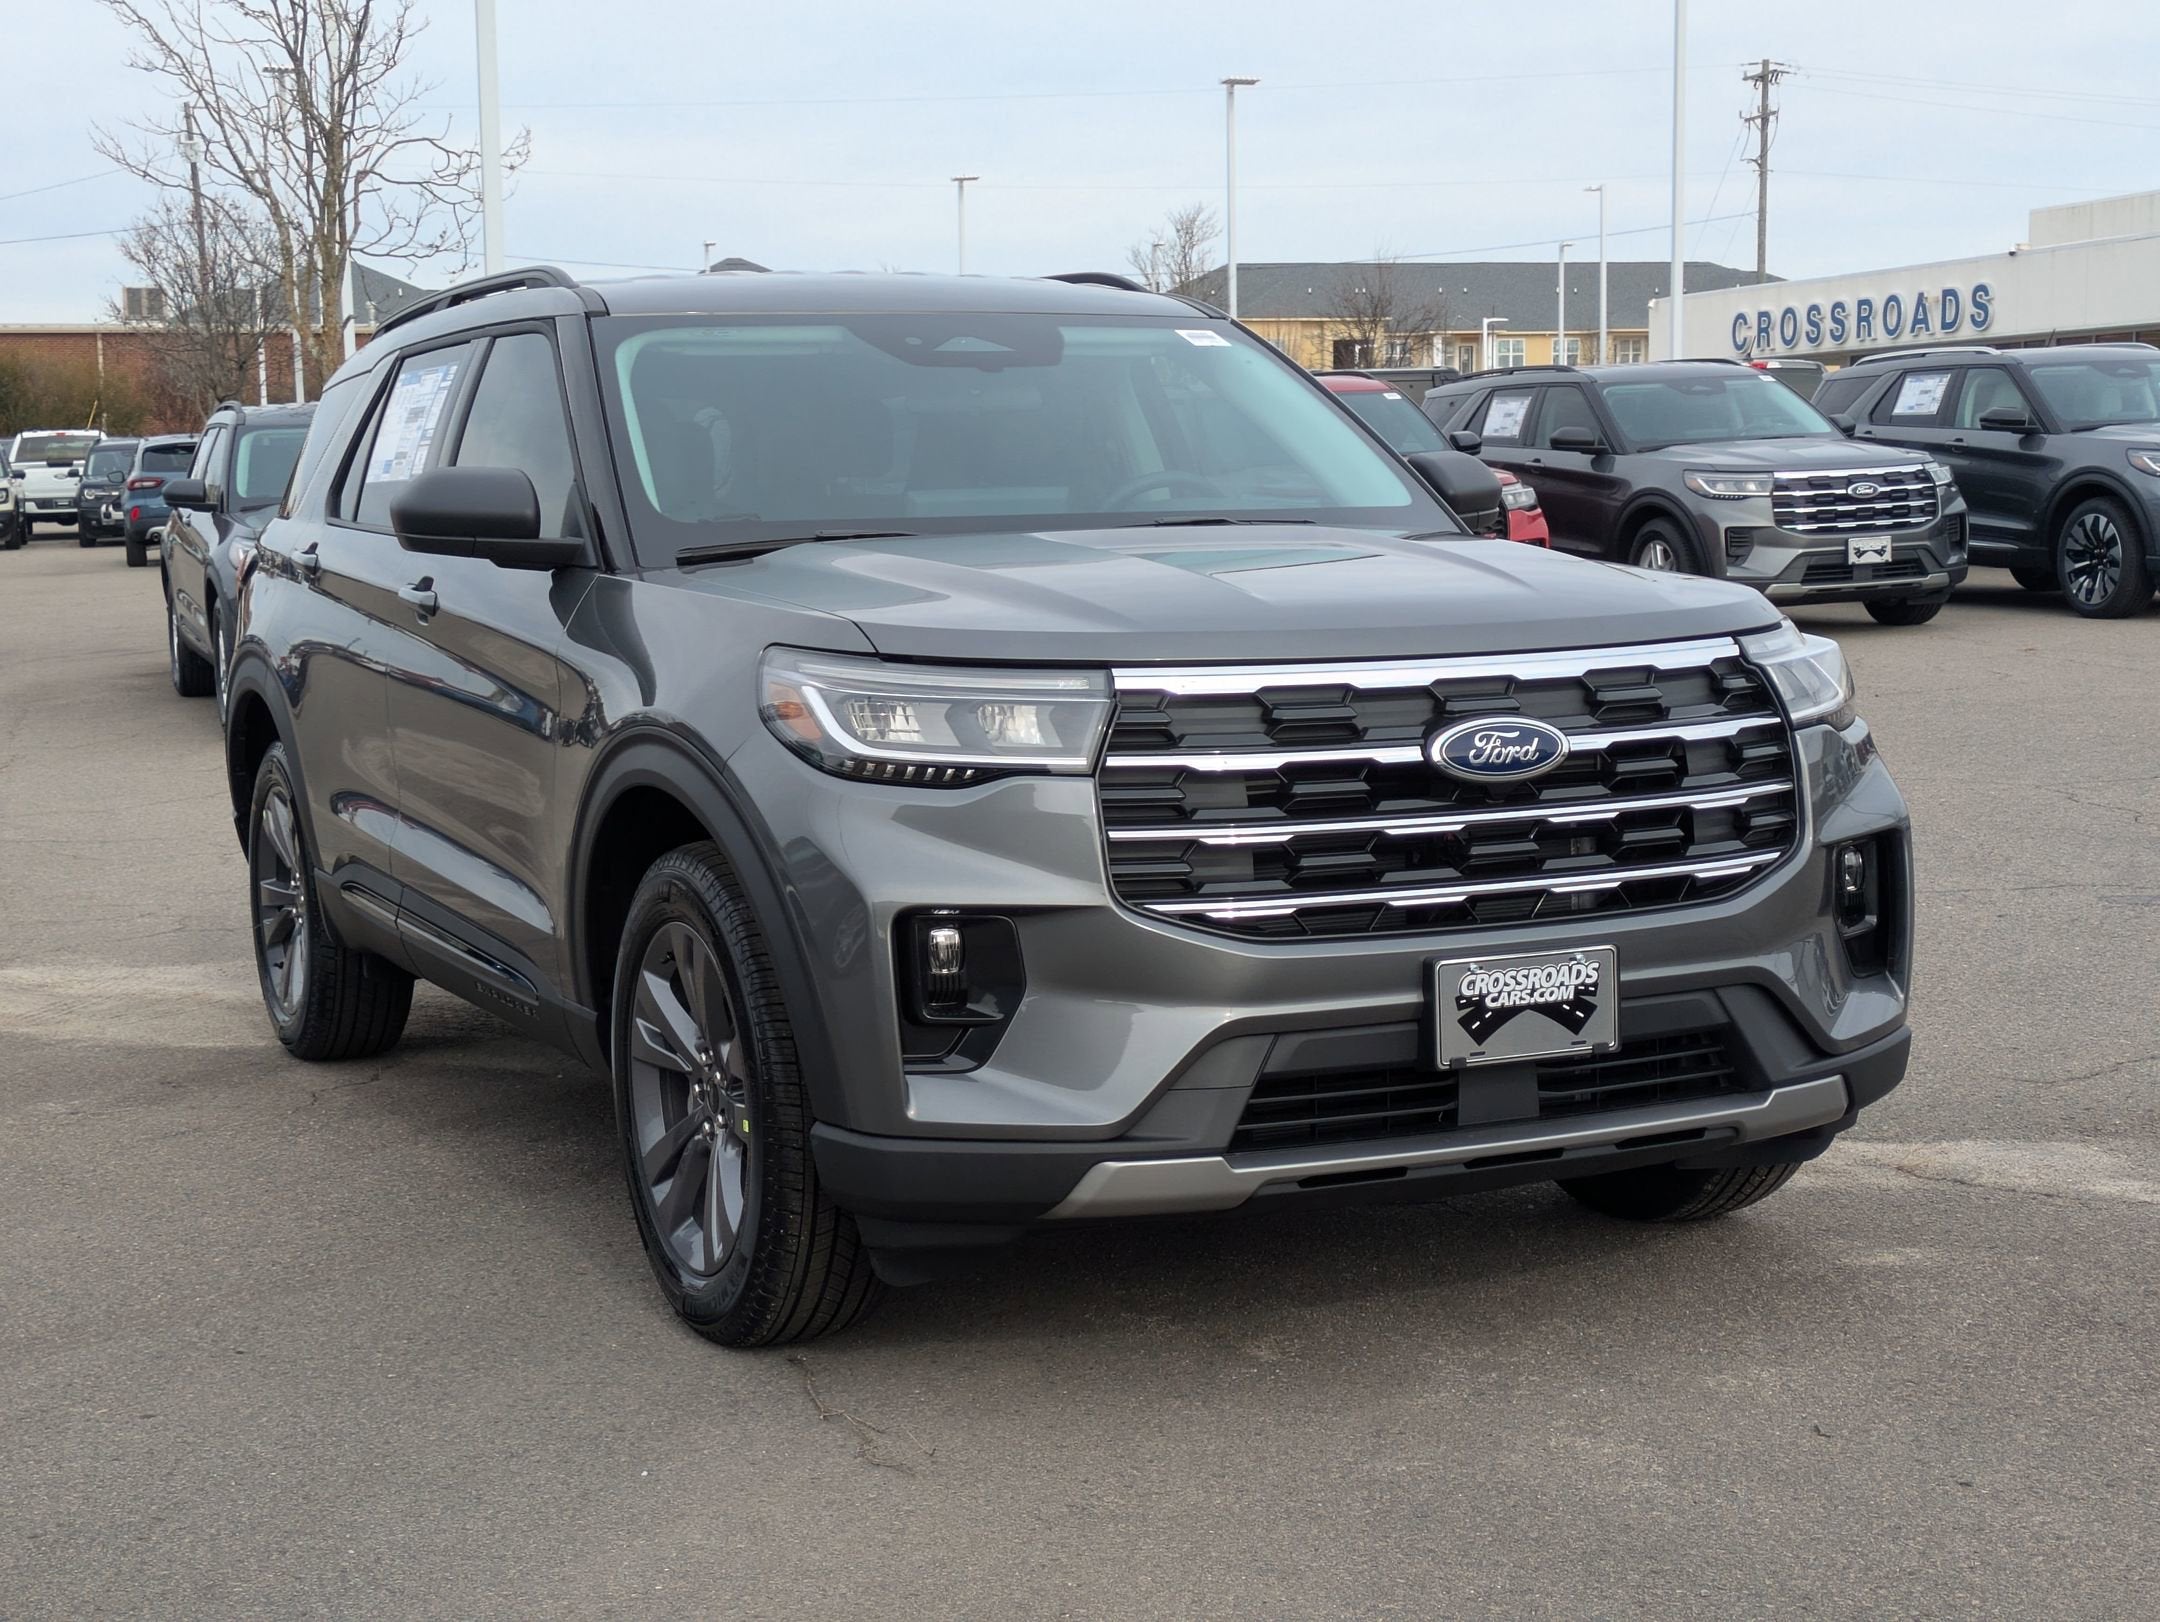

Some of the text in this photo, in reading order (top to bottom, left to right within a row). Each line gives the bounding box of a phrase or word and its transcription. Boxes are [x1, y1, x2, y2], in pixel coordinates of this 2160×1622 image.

[1731, 283, 1992, 352] CROSSROADS
[1468, 730, 1540, 766] Ford
[1459, 961, 1600, 997] CROSSROADS
[1485, 984, 1576, 1009] CARS.COM
